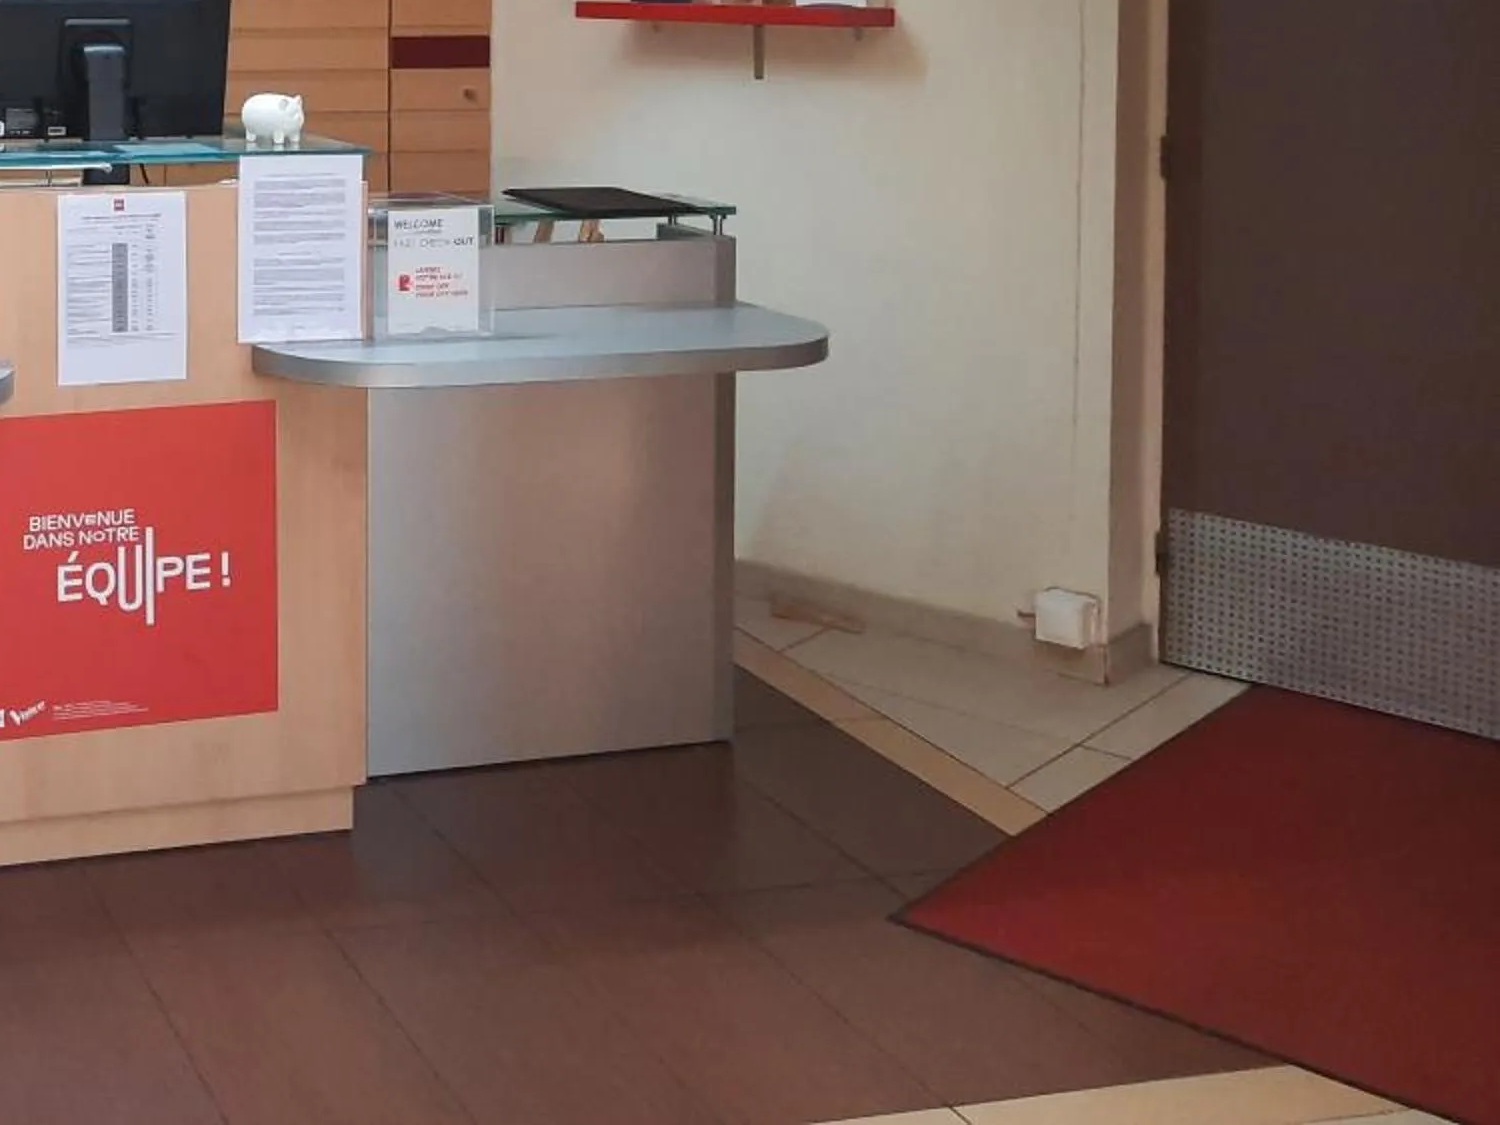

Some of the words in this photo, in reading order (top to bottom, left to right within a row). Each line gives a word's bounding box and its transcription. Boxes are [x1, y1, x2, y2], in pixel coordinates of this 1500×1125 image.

[393, 218, 444, 230] WELCOME
[28, 507, 136, 532] BIENVENUE
[23, 532, 75, 550] DANS
[78, 526, 141, 546] NOTRE
[56, 526, 211, 626] ÉQUIPE
[219, 551, 232, 588] !
